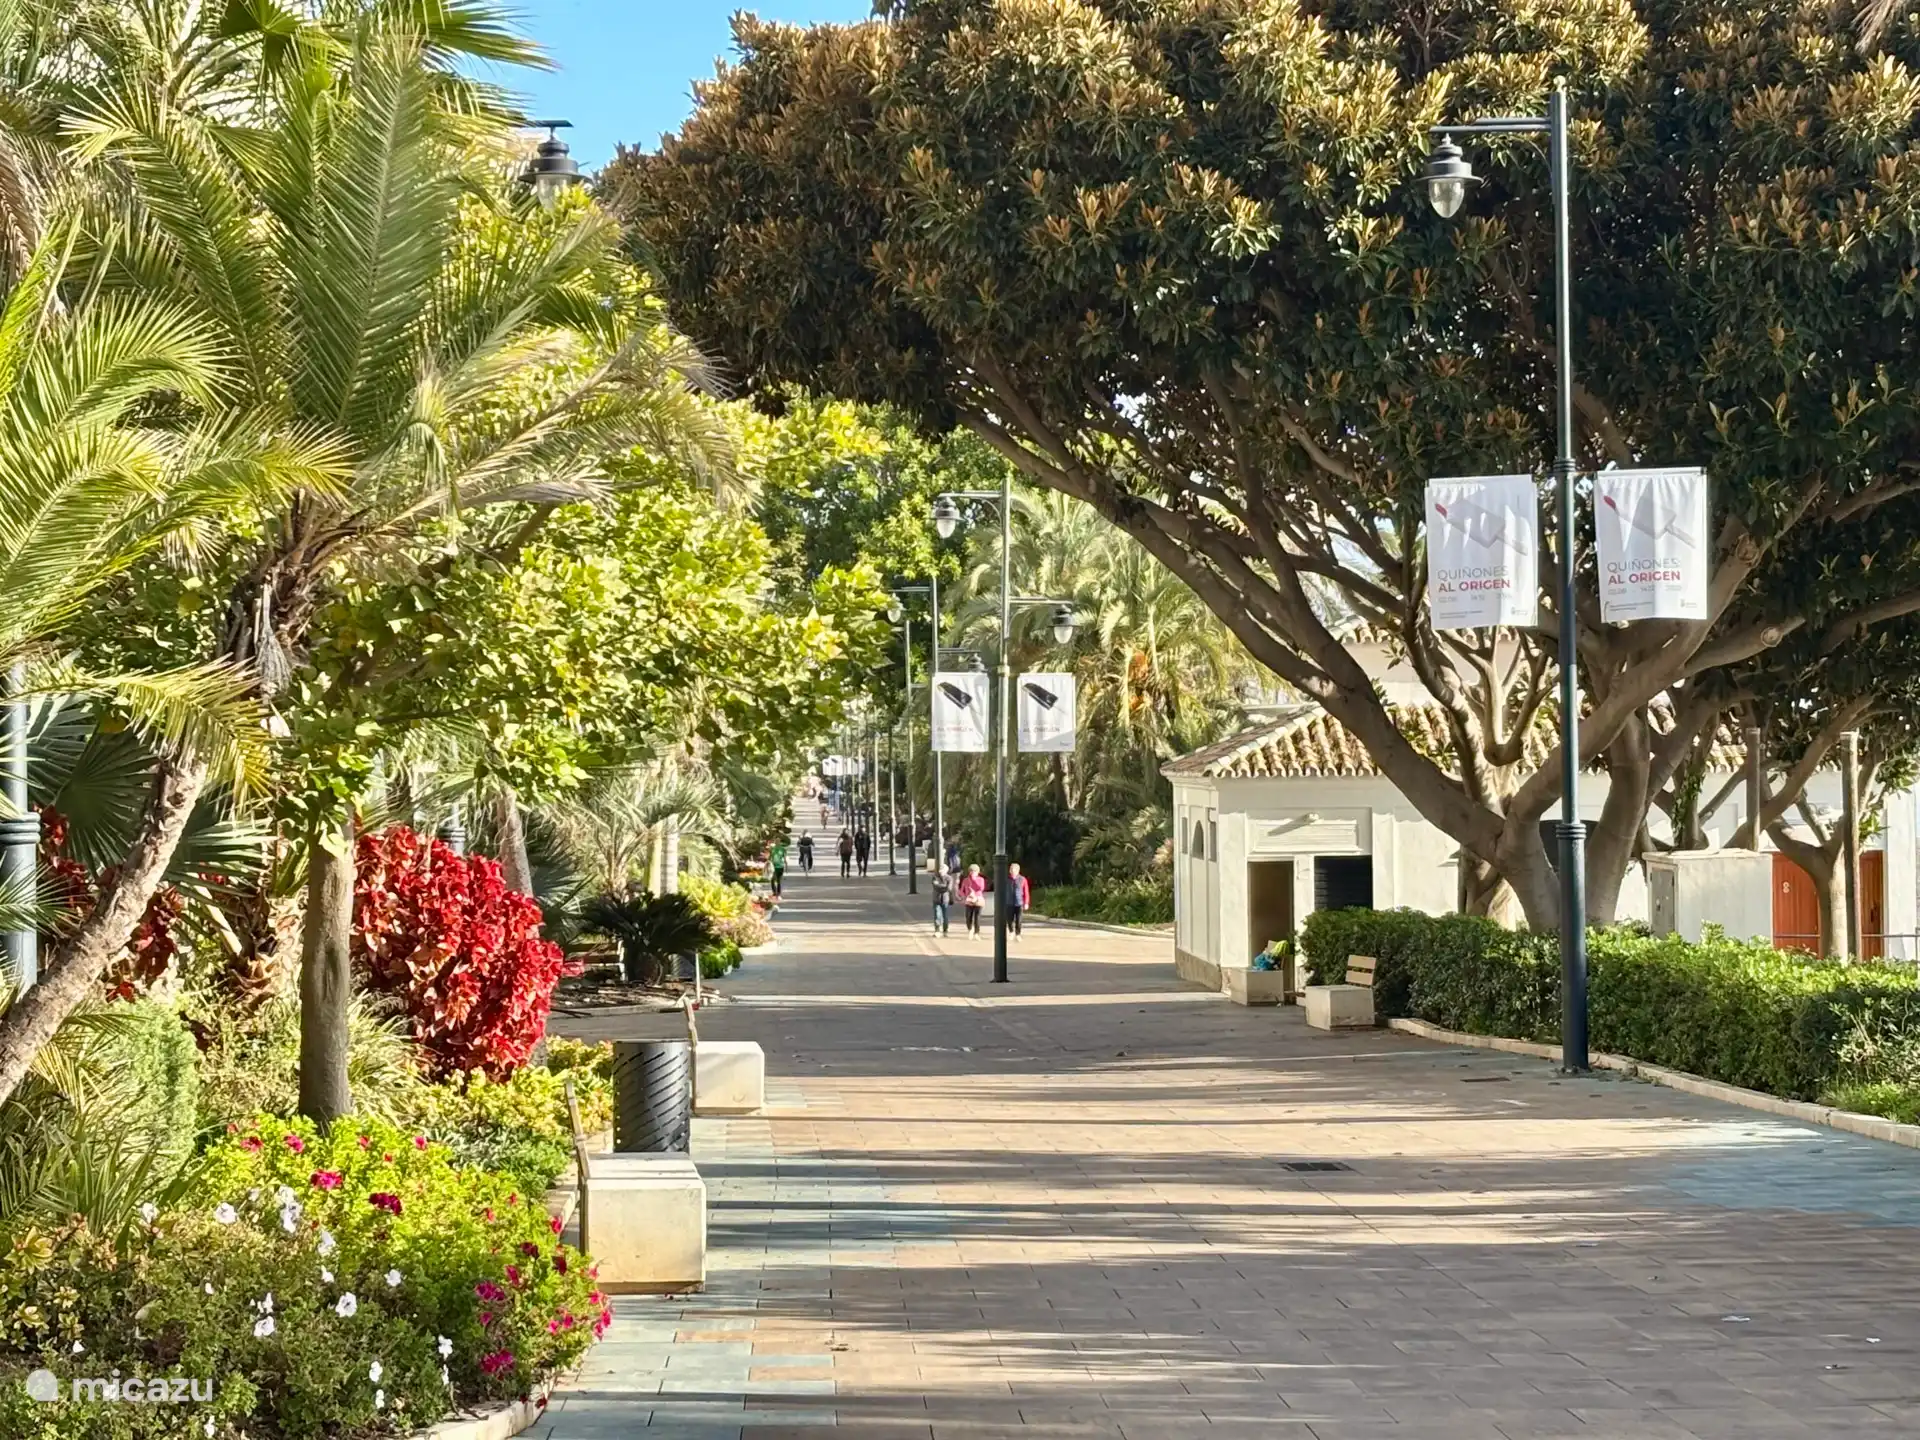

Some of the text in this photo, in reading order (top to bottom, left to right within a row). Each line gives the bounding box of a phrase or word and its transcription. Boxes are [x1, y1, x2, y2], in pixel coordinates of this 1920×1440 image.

[1607, 557, 1681, 573] QUIÑONES
[1437, 565, 1509, 582] QUIÑONES
[1608, 570, 1681, 585] AL ORIGEN
[1438, 578, 1511, 593] AL ORIGEN
